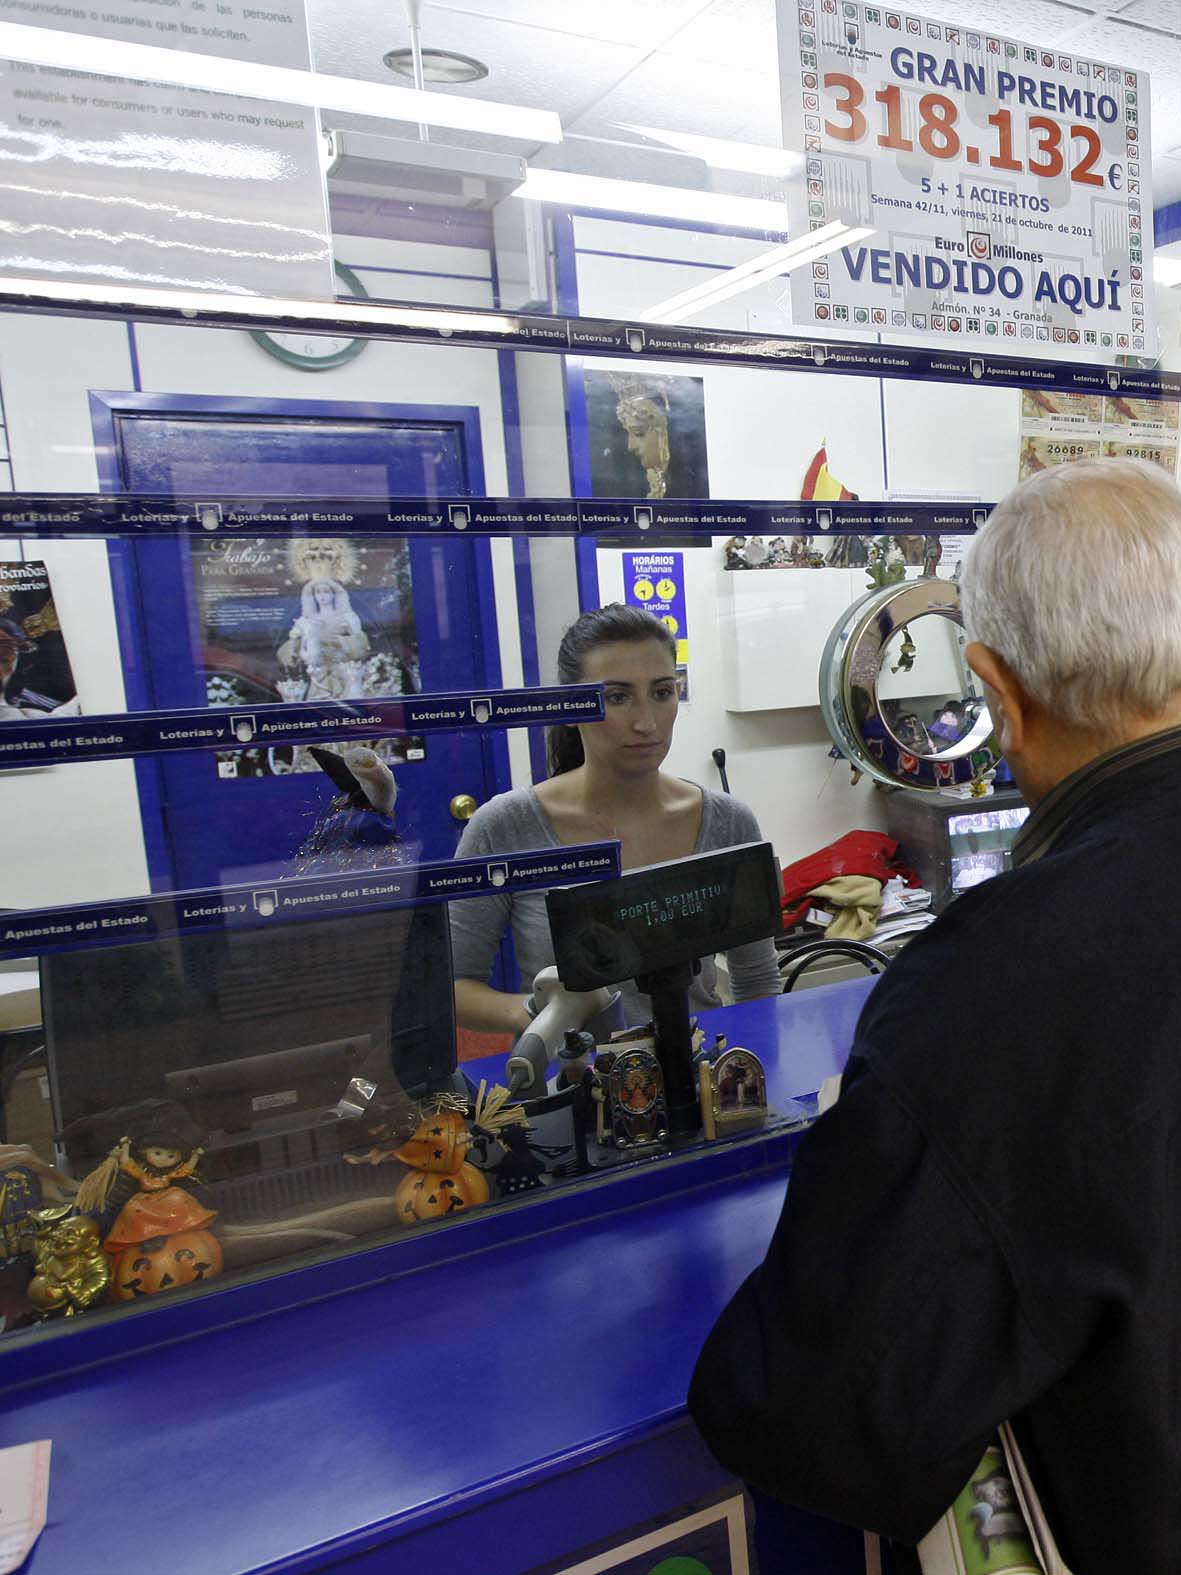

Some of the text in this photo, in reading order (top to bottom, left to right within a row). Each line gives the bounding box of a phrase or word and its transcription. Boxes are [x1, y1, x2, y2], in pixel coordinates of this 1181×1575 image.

[243, 8, 293, 24] personas
[155, 20, 178, 33] que
[180, 22, 198, 35] las
[890, 47, 1119, 123] GRAN PREMIO
[176, 105, 207, 120] users
[210, 109, 235, 123] who
[237, 113, 261, 127] may
[263, 116, 304, 131] request
[921, 178, 1050, 213] 5 + 1 ACIERTOS
[871, 194, 1093, 239] Semana 42/11, viernes, 21 de octubre de 2011
[935, 237, 1044, 265] Euro Millones
[841, 246, 1122, 315] VENDIDO AQUÍ
[931, 301, 970, 317] Admón.
[989, 306, 1001, 317] 34
[1013, 309, 1053, 324] Granada
[531, 329, 566, 340] Estado
[649, 338, 691, 351] Apuestas
[830, 354, 909, 368] Apuestas Estado
[987, 367, 1018, 378] Apuestas
[1048, 444, 1084, 454] 26689
[29, 512, 81, 523] Estado
[228, 512, 287, 525] Apuestas
[289, 512, 310, 523] del
[312, 512, 354, 523] Estado
[434, 513, 578, 526] y Apuestas del Estado
[656, 515, 747, 526] Apuestas del Estado
[835, 516, 913, 527] Apuestas del Estado
[632, 555, 674, 565] HORÁRIOS
[635, 565, 673, 574] Mañanas
[643, 602, 671, 611] Tardes
[456, 710, 466, 719] y
[496, 703, 544, 715] Apuestas
[546, 702, 562, 712] del
[563, 700, 597, 710] Estado
[216, 727, 225, 738] y
[261, 721, 319, 733] Apuestas
[321, 718, 339, 728] del
[342, 715, 382, 726] Estado
[50, 735, 124, 748] del Estado
[475, 875, 482, 885] y
[512, 865, 559, 878] Apuestas
[562, 863, 577, 873] del
[578, 857, 611, 869] Estado
[239, 903, 248, 913] y
[283, 893, 339, 906] Apuestas
[341, 888, 359, 899] del
[361, 885, 401, 897] Estado
[620, 900, 658, 920] PORTE
[681, 901, 704, 917] EUR
[5, 915, 148, 940] Apuestas del Estado
